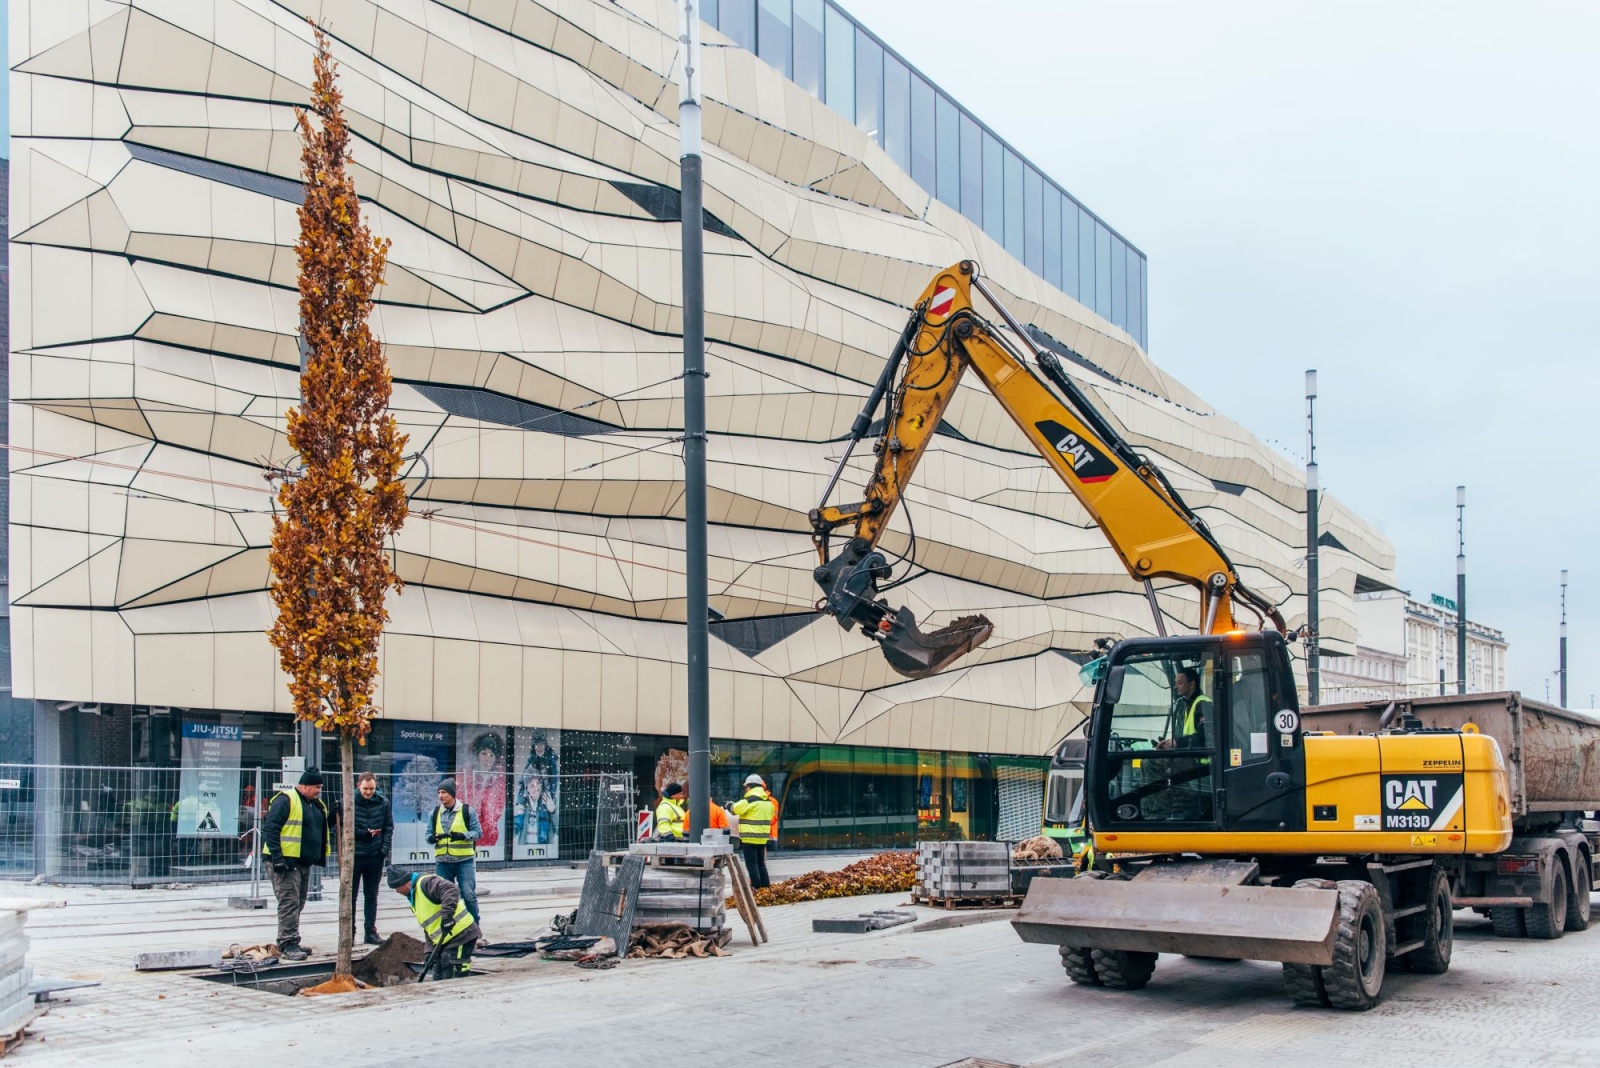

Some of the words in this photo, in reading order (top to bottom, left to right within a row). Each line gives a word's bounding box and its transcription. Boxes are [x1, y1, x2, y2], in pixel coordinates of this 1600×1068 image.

[1056, 433, 1095, 471] CAT
[1279, 713, 1294, 729] 30
[192, 724, 238, 735] JIU-JITSU
[1385, 780, 1437, 810] CAT
[1386, 815, 1430, 828] M313D
